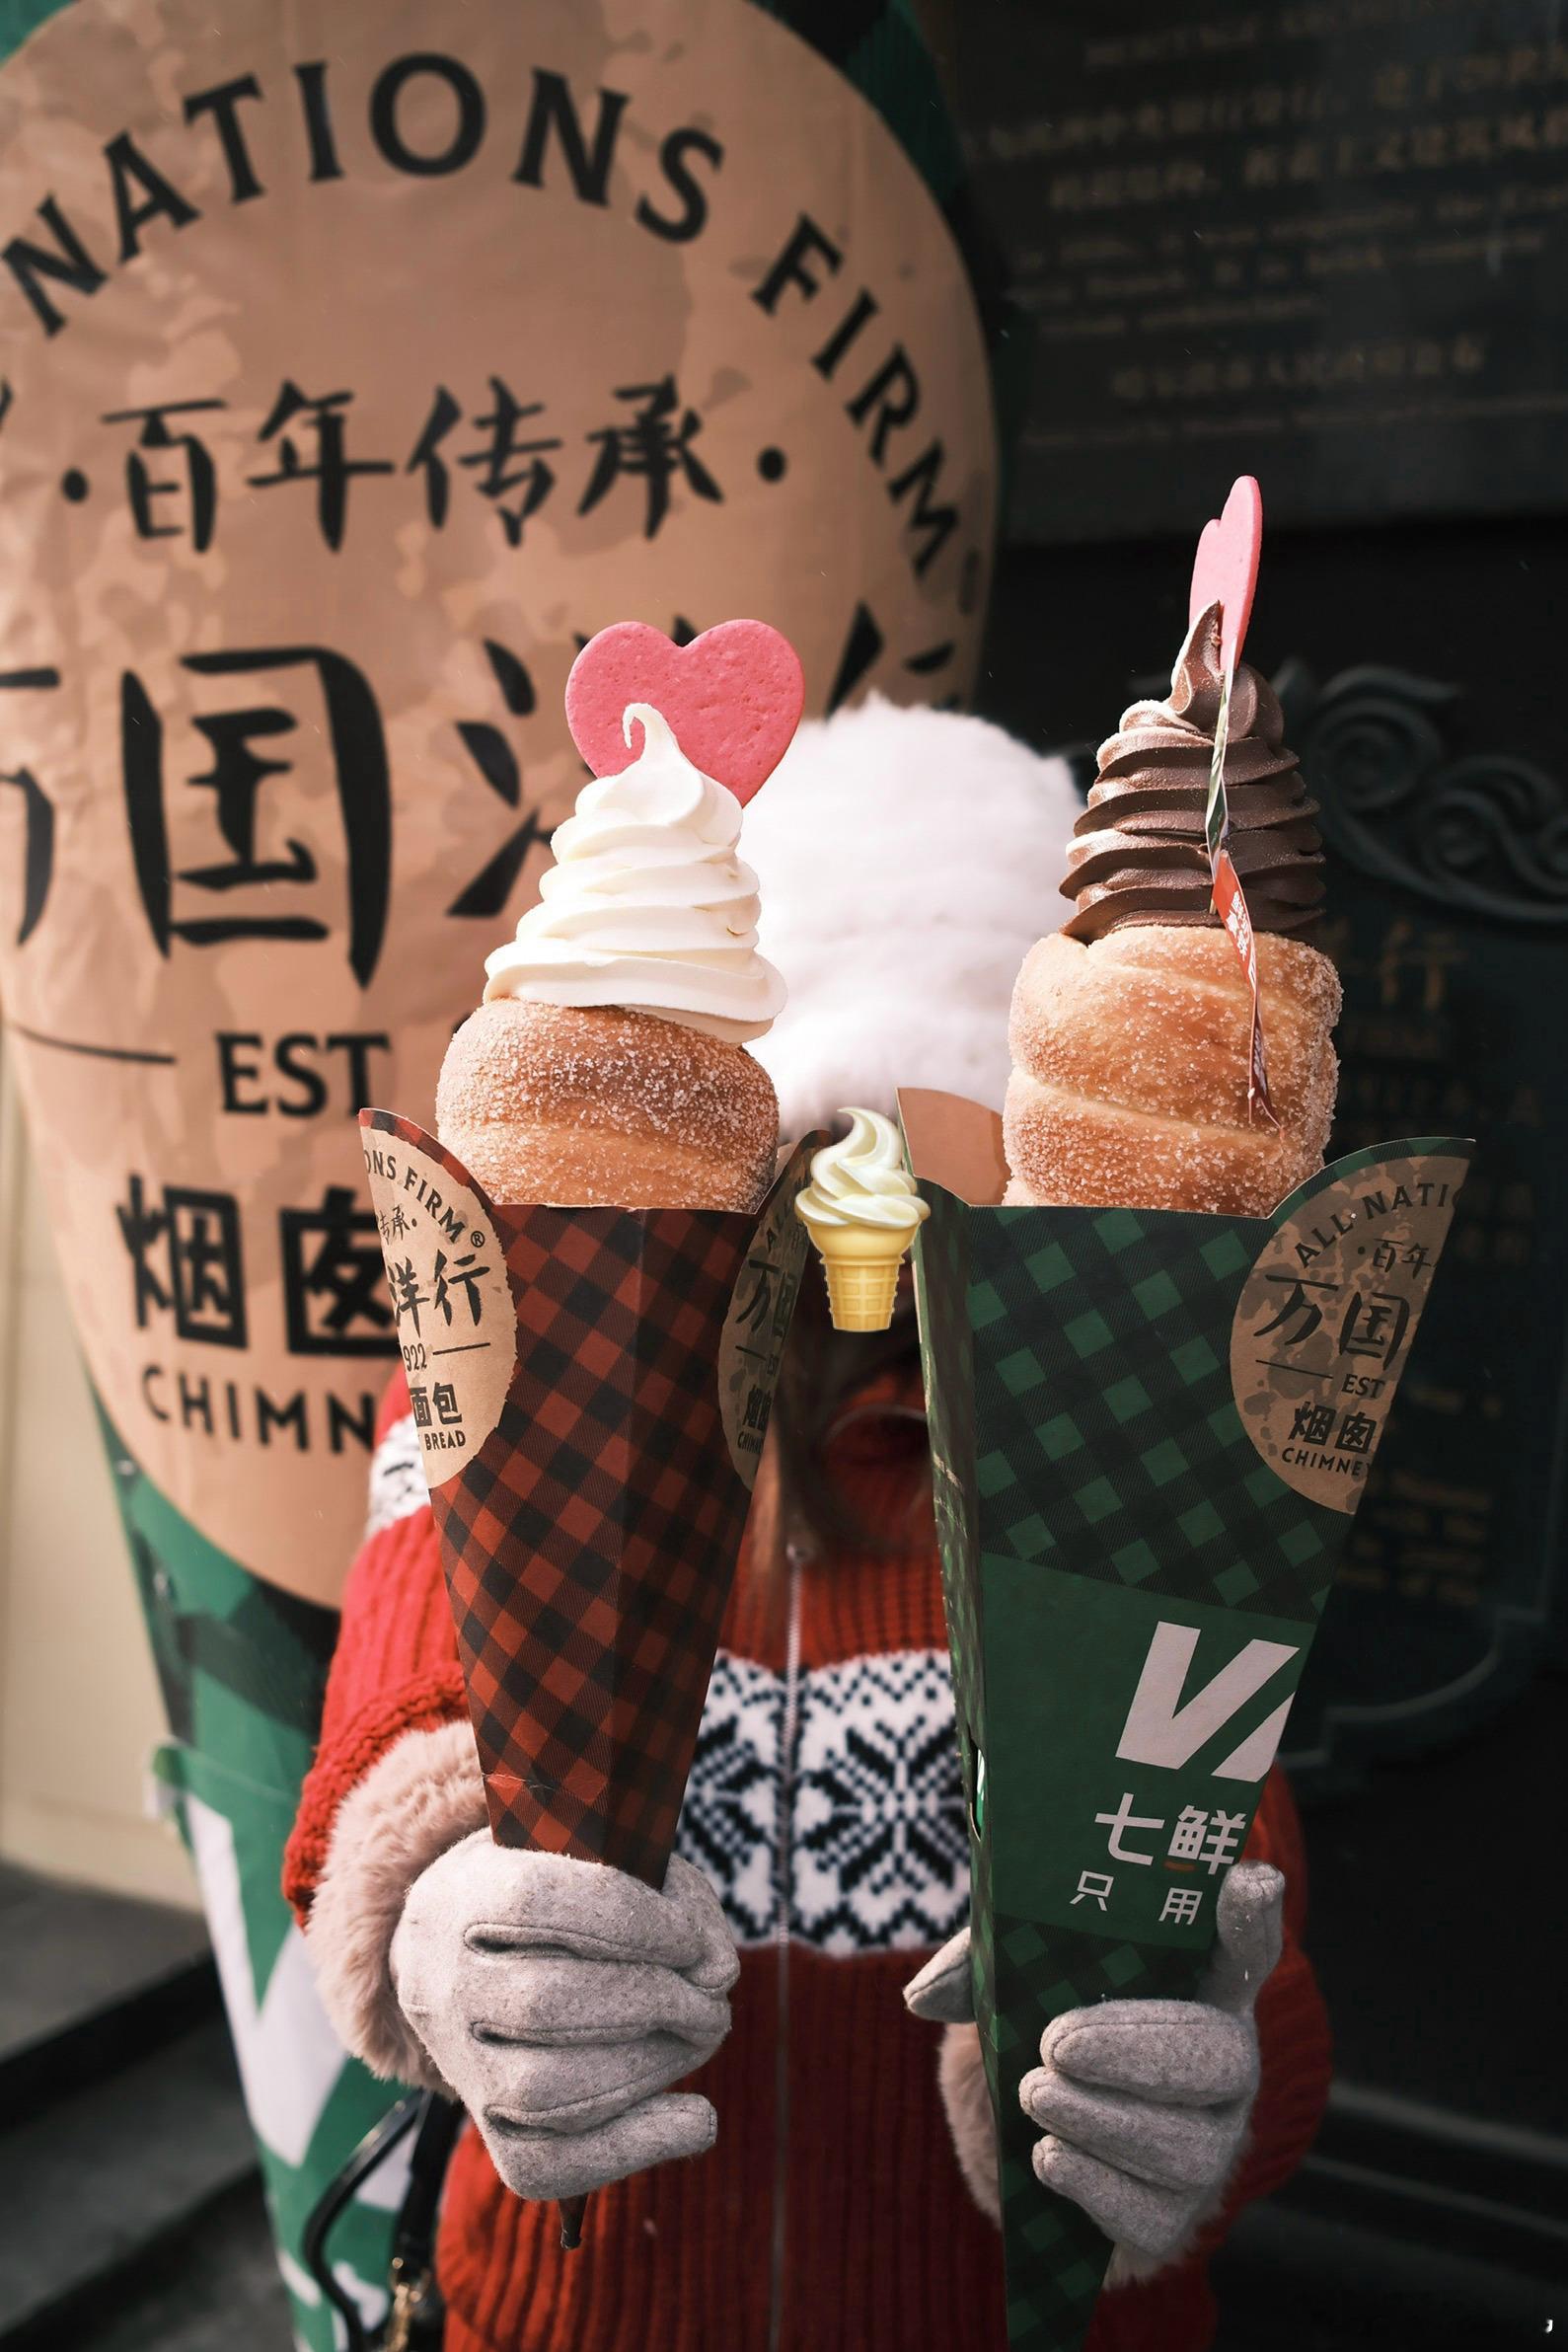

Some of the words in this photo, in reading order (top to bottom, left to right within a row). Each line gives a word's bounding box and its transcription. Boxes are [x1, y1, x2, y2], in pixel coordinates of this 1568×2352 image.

[0, 51, 724, 339] NATIONS
[214, 1031, 391, 1118] EST
[1295, 1214, 1355, 1269] ALL
[388, 1249, 490, 1338] 洋行
[1253, 1274, 1410, 1371] 万国
[410, 1382, 462, 1427] 面包
[1341, 1373, 1385, 1399] EST
[424, 1430, 467, 1451] BREAD
[1288, 1401, 1378, 1454] 烟囱
[1094, 1792, 1247, 1875] 七鲜
